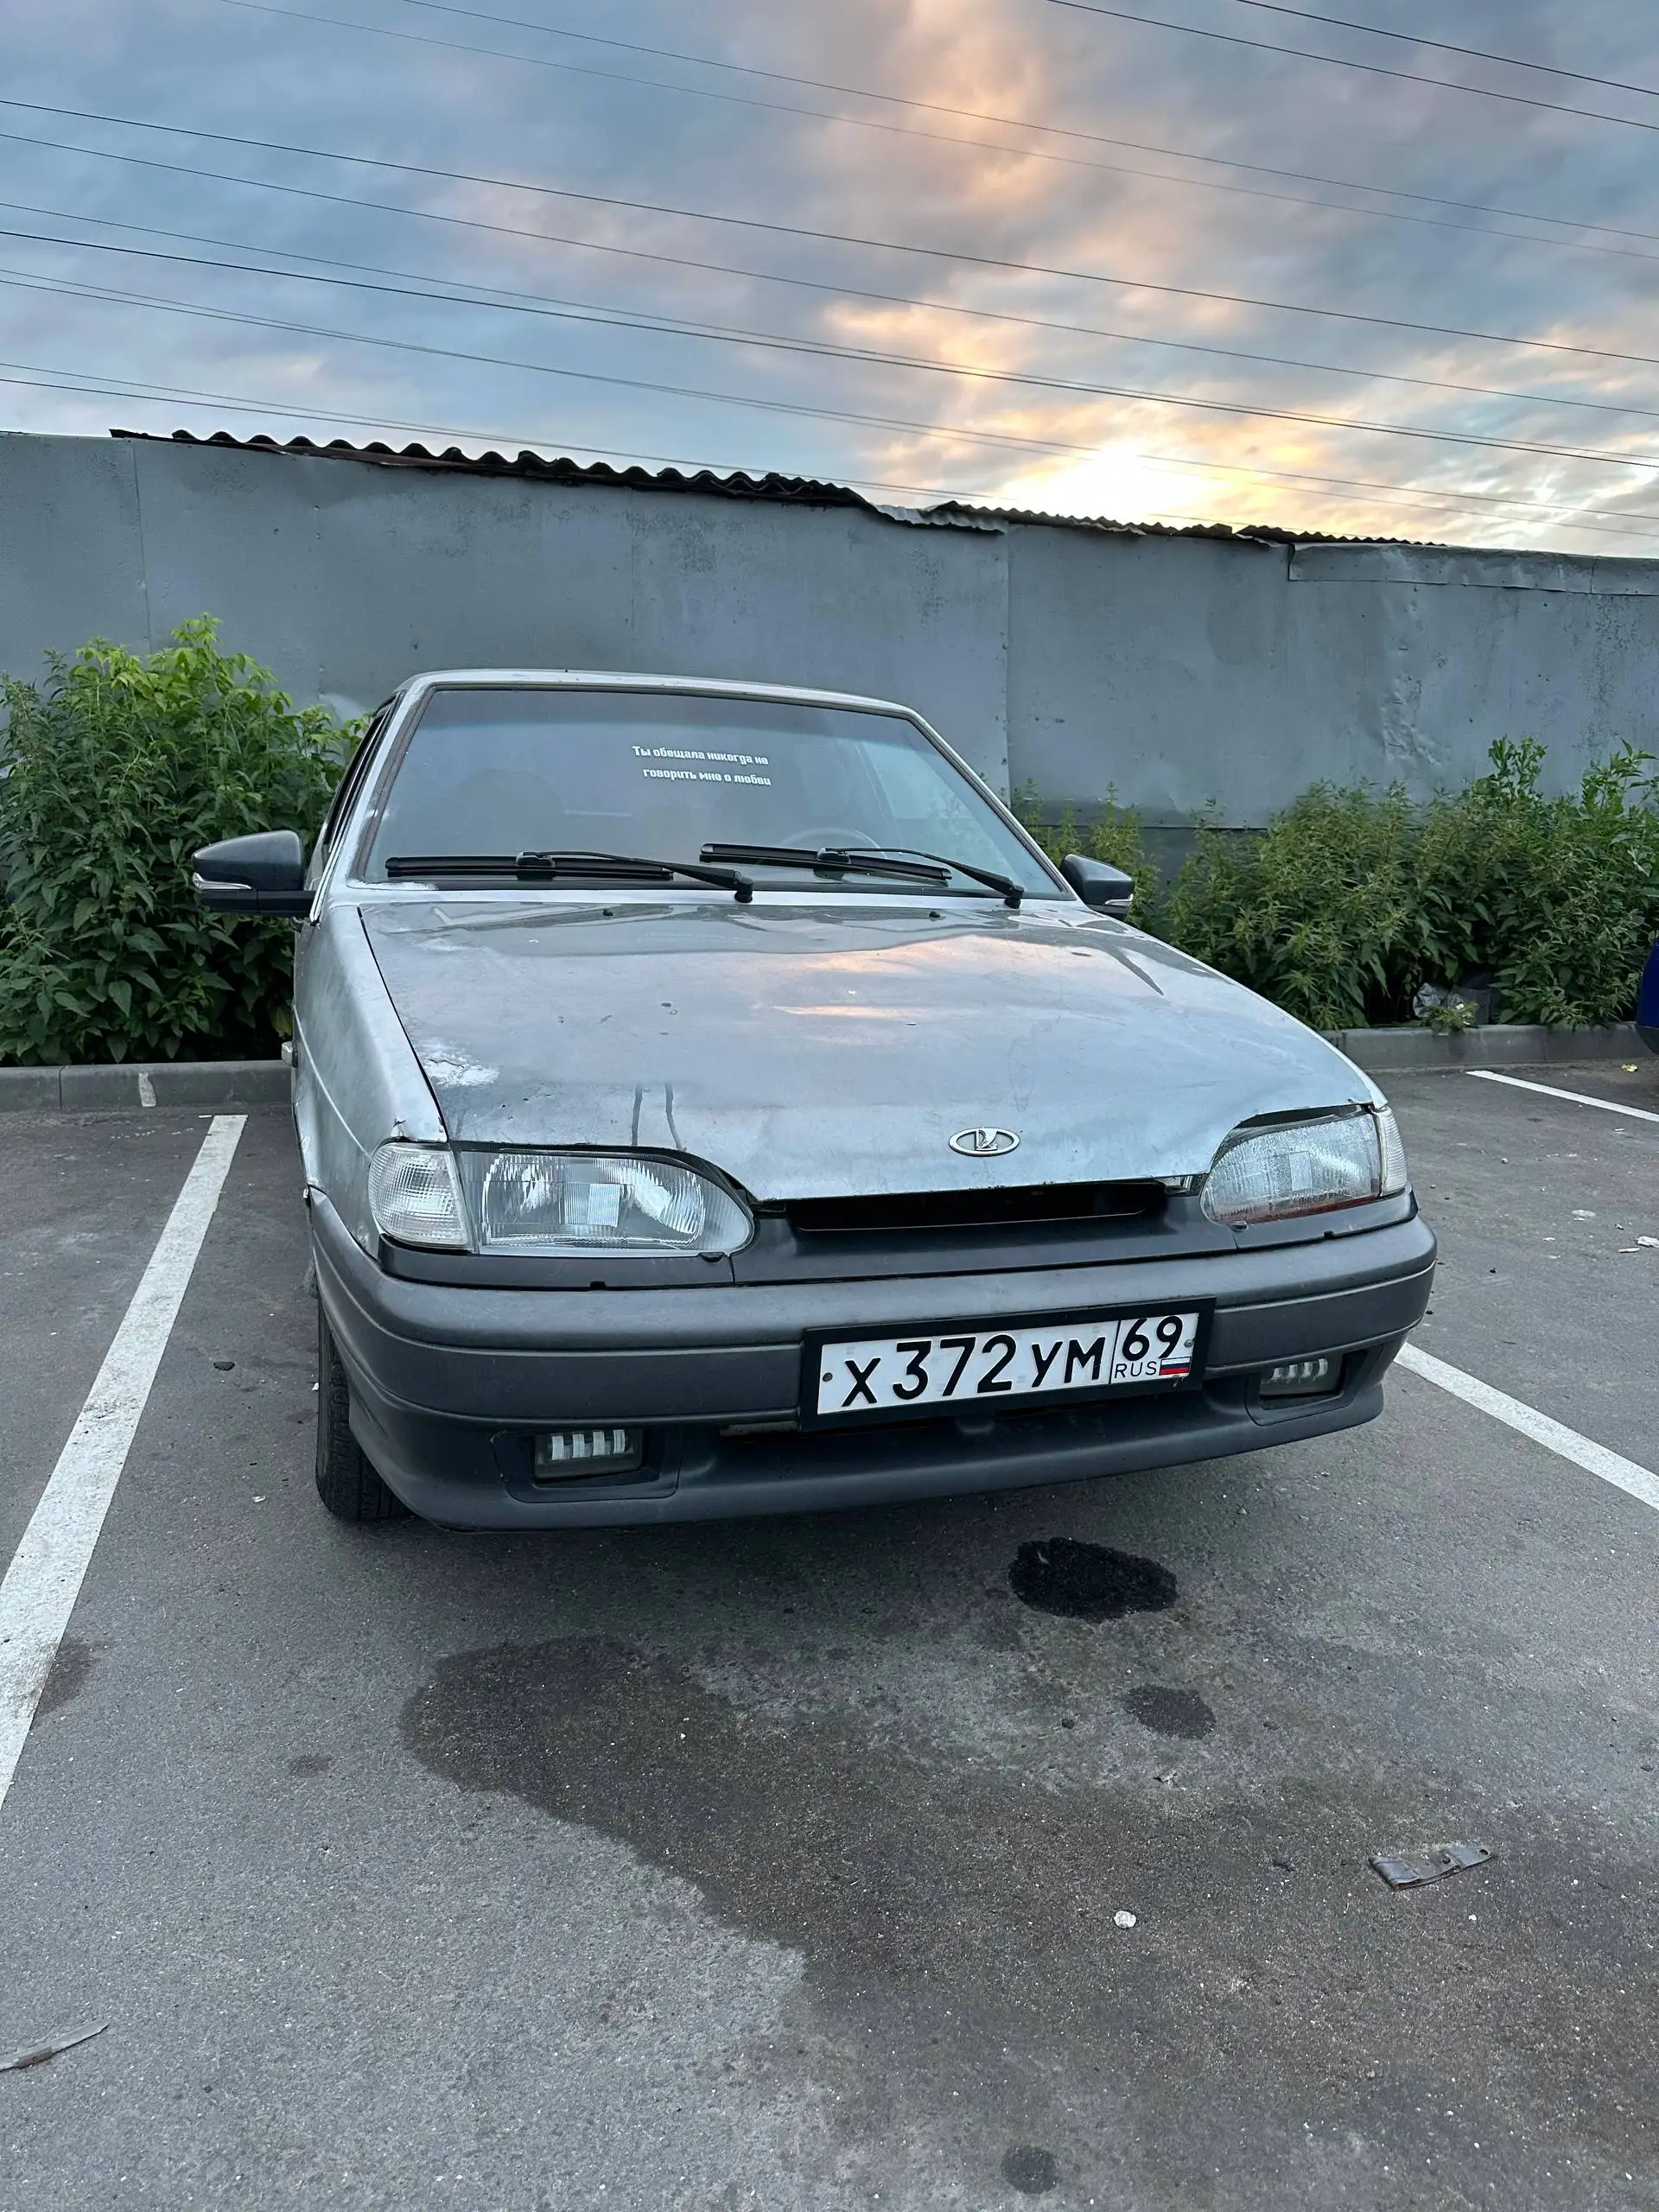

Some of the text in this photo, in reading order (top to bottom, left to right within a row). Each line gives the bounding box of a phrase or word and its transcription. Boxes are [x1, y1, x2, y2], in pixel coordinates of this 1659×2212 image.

[632, 746, 651, 756] Ты
[653, 747, 705, 760] обещала
[707, 752, 753, 766] никогда
[643, 768, 772, 785] говорить мне о любви
[1122, 1315, 1183, 1361] 69
[1114, 1361, 1157, 1378] RUS
